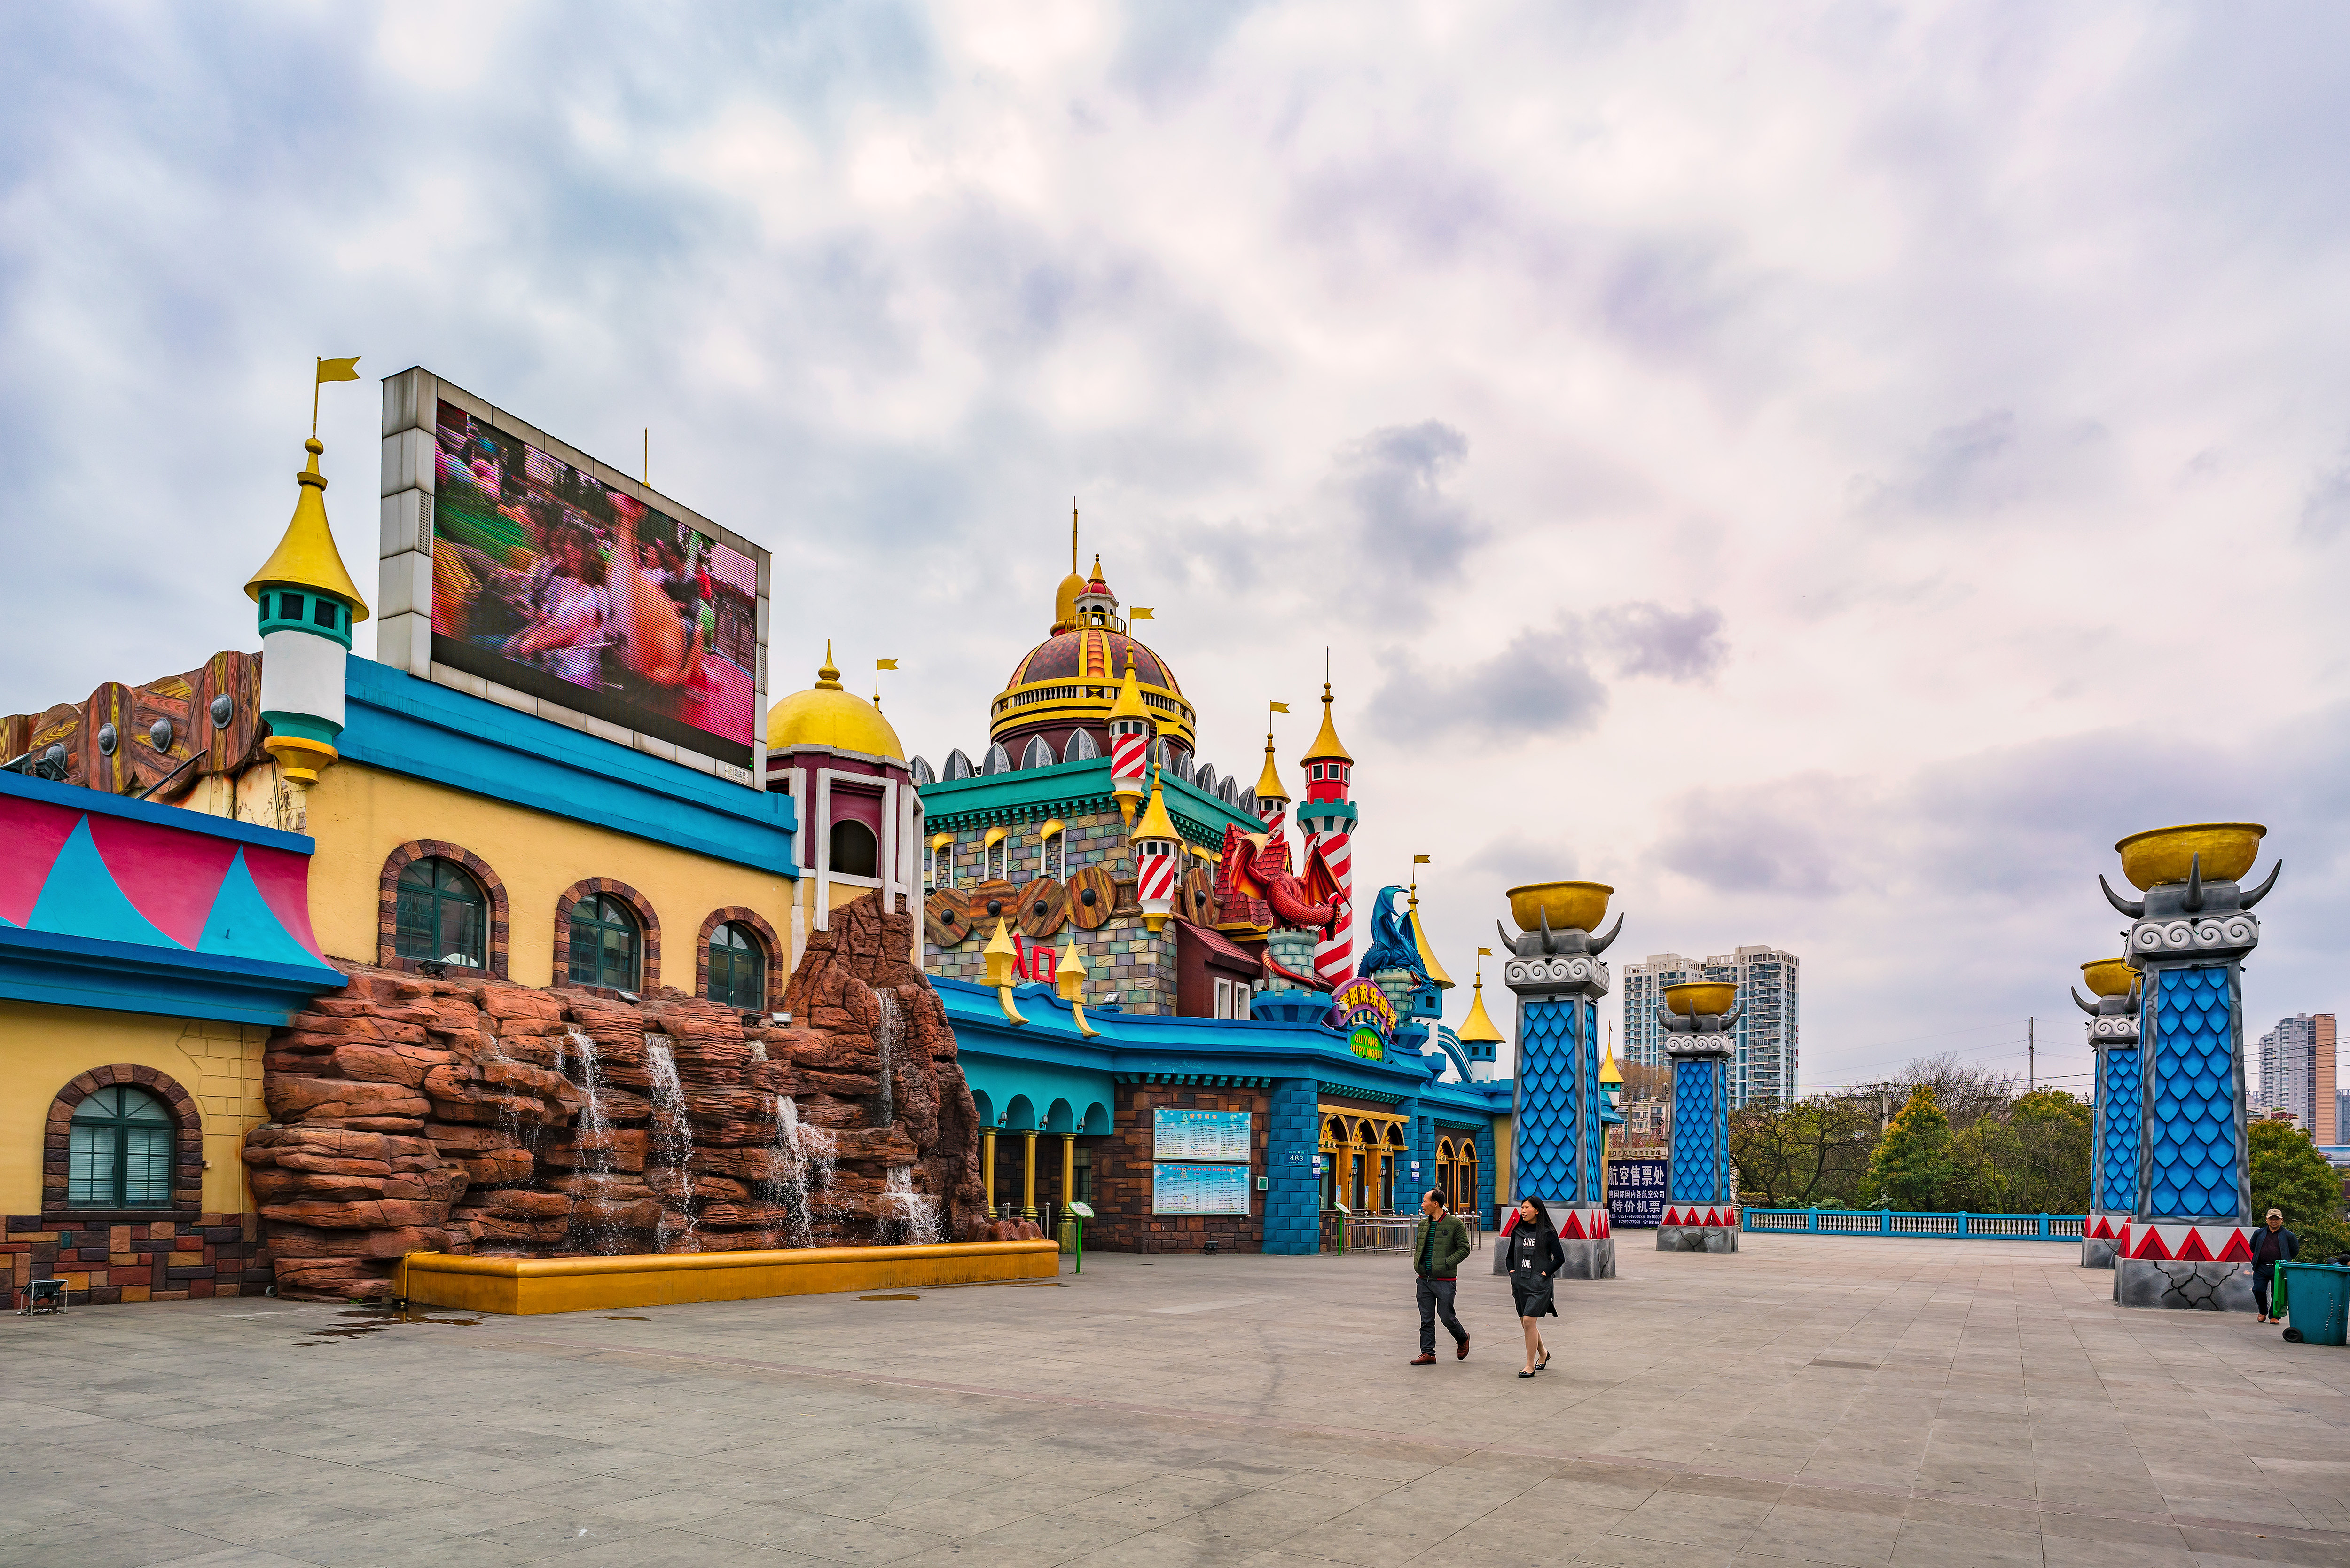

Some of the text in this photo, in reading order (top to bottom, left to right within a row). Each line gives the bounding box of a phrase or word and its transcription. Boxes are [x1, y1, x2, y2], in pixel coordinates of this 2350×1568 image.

[1355, 1034, 1378, 1047] GUIYANG
[1366, 1048, 1382, 1059] WORLD
[1608, 1165, 1664, 1186] 航空售票处
[1612, 1200, 1660, 1213] 特价机票
[1523, 1238, 1535, 1246] SURE
